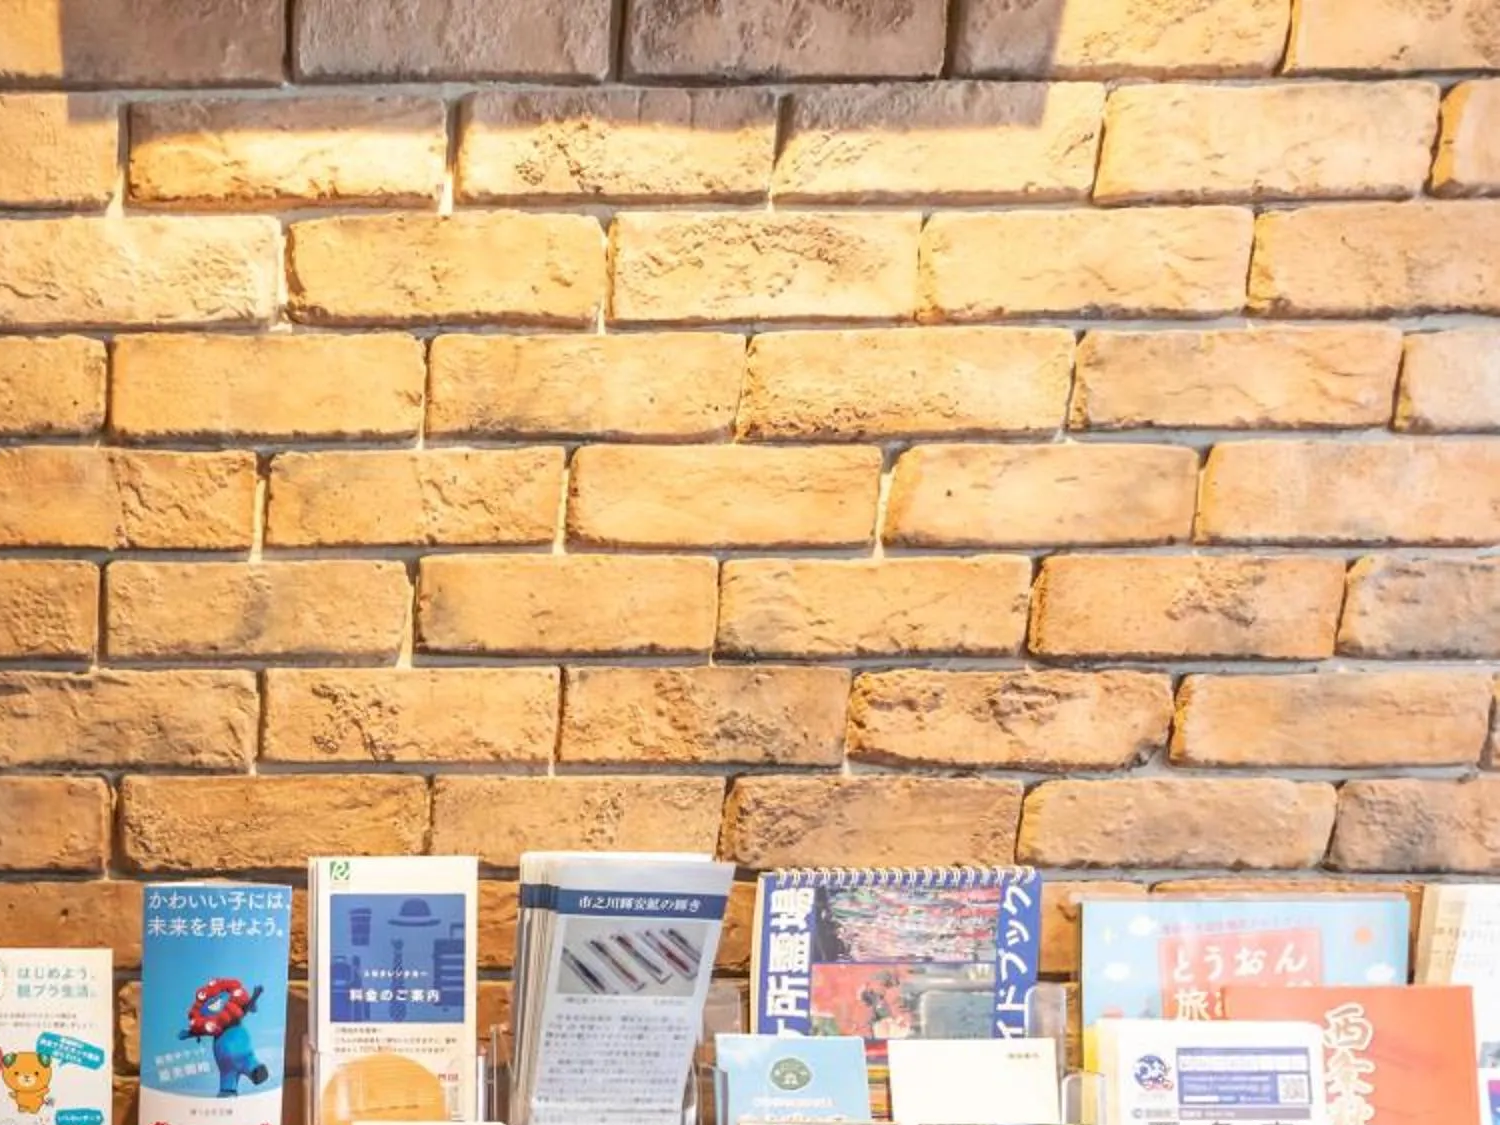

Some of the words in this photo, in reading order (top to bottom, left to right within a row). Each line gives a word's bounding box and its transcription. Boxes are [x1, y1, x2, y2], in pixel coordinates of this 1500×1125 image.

[148, 891, 291, 911] かわいい子には、
[148, 916, 284, 937] 未来を見せよう。
[1173, 943, 1308, 983] とうおん
[349, 988, 440, 1003] 料金のご案内
